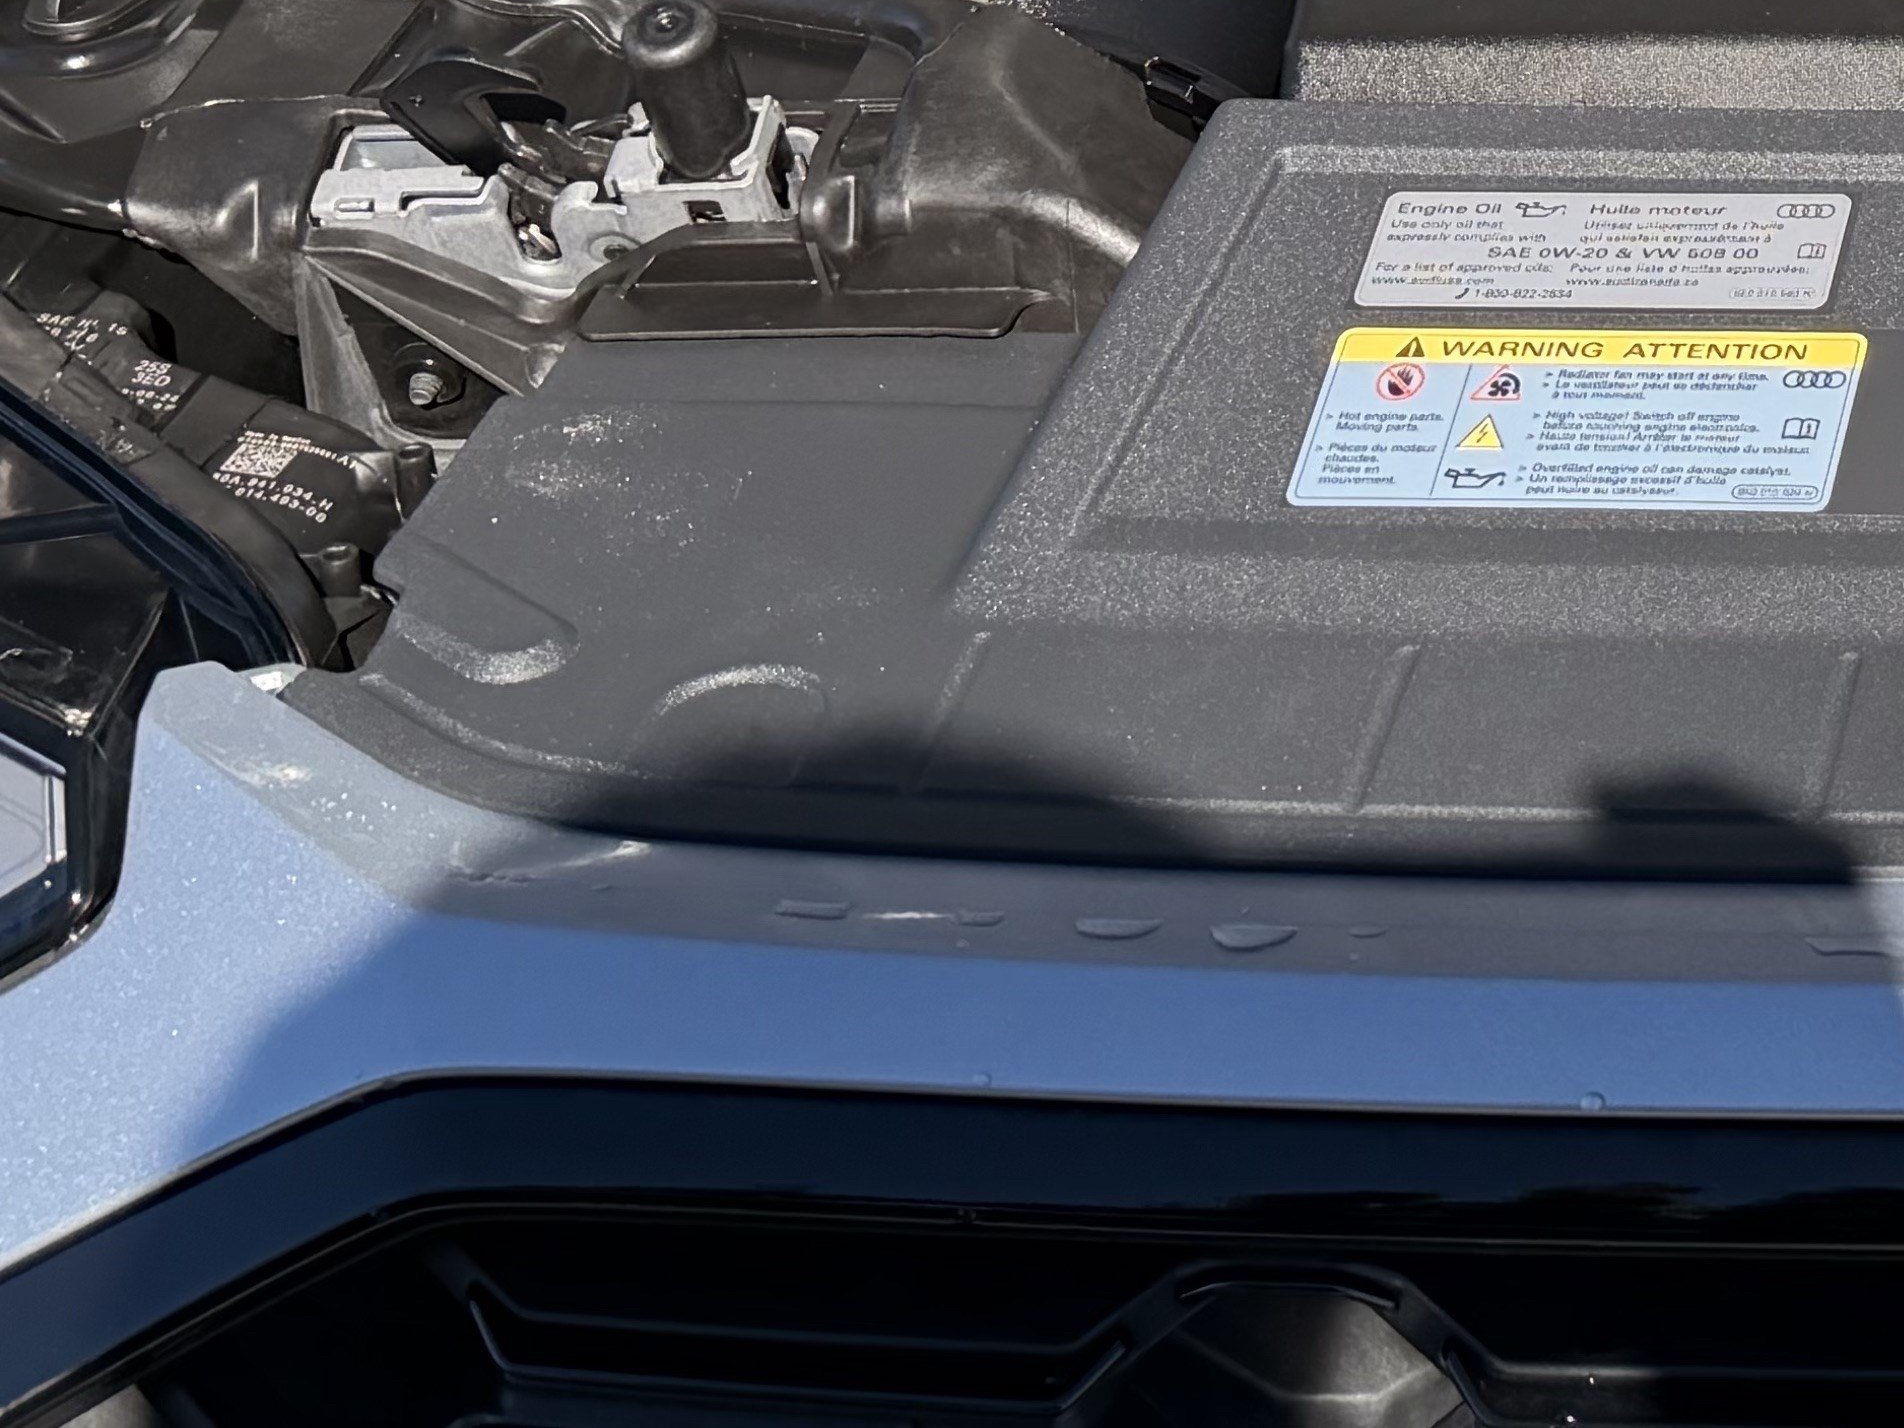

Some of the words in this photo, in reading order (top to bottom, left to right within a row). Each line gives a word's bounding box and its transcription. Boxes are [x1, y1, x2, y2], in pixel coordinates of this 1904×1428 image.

[1398, 202, 1468, 216] Engine
[1475, 202, 1502, 214] Oil
[1589, 204, 1641, 215] Huile
[1649, 205, 1727, 215] moteur
[1391, 219, 1418, 229] Use
[1421, 219, 1452, 231] only
[1456, 219, 1474, 229] oil
[1476, 219, 1504, 229] that
[1386, 233, 1451, 244] expressly
[1454, 233, 1514, 244] complies
[1518, 232, 1547, 243] with
[1579, 234, 1604, 246] qui
[1488, 246, 1532, 259] SAE
[1538, 247, 1609, 259] 0W-20
[1615, 248, 1632, 259] &
[1643, 248, 1681, 259] VW
[1733, 248, 1759, 259] 00
[1376, 262, 1399, 272] For
[1413, 262, 1435, 272] list
[1438, 262, 1454, 272] of
[1456, 262, 1522, 274] approved
[1570, 263, 1601, 273] Pour
[1605, 264, 1631, 273] une
[1442, 340, 1604, 359] WARNING
[1622, 342, 1809, 361] ATTENTION
[1558, 369, 1610, 379] Radiator
[1613, 369, 1633, 379] fan
[1636, 371, 1664, 381] may
[1667, 371, 1695, 380] start
[1697, 372, 1709, 381] at
[1712, 373, 1737, 382] any
[1738, 372, 1769, 381] time.
[1555, 380, 1570, 389] Le
[1563, 391, 1588, 399] tout
[1338, 411, 1361, 421] Hot
[1364, 412, 1407, 422] engine
[1409, 413, 1445, 423] parts.
[1545, 411, 1575, 422] High
[1632, 411, 1675, 421] Switch
[1677, 412, 1697, 421] off
[1335, 421, 1384, 433] Moving
[1385, 423, 1419, 433] parts.
[1542, 421, 1583, 430] before
[1644, 423, 1687, 433] engine
[1328, 442, 1368, 452] Pièces
[1371, 444, 1388, 452] du
[1391, 444, 1437, 453] moteur
[1325, 454, 1379, 463] chaudes.
[1322, 464, 1362, 474] Pièces
[1364, 465, 1380, 474] en
[1532, 463, 1594, 473] Overfilled
[1596, 465, 1640, 474] engine
[1642, 464, 1659, 474] oil
[1661, 466, 1684, 475] can
[1686, 466, 1737, 476] damage
[1317, 476, 1396, 484] mouvement.
[1529, 474, 1548, 483] Un
